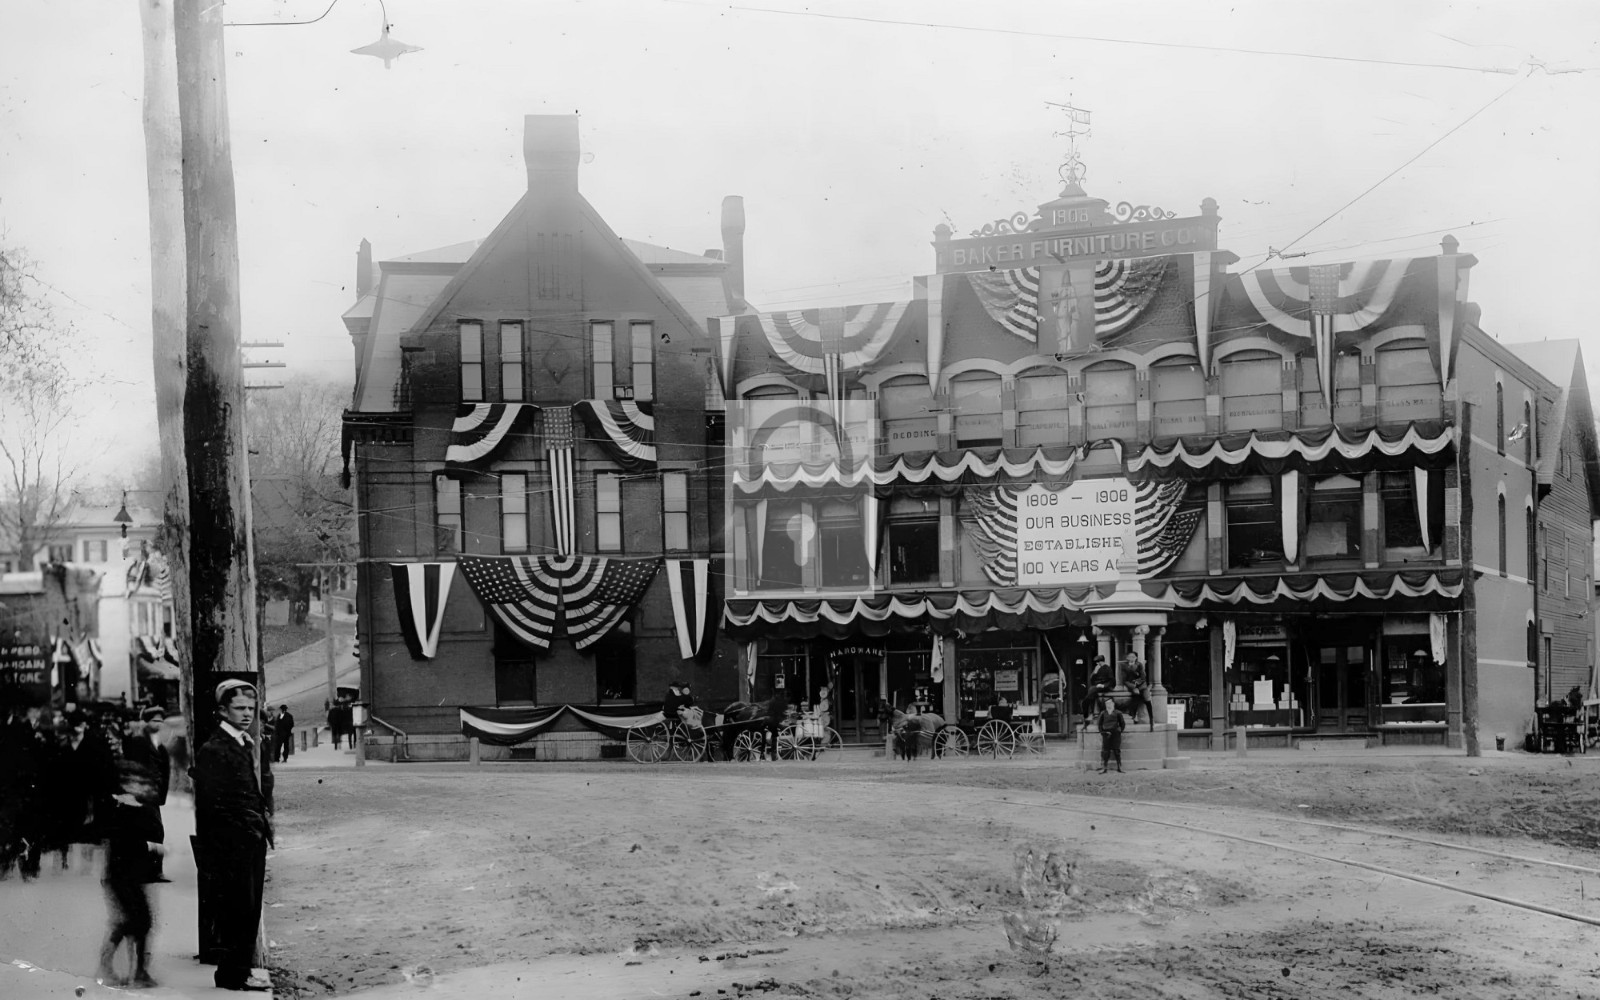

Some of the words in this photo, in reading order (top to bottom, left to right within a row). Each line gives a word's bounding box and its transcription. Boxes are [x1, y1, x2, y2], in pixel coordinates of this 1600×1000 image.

[953, 243, 1024, 266] BAKER
[1031, 232, 1156, 258] FURNITURE
[1161, 228, 1196, 246] CO.
[1026, 493, 1058, 507] 1808
[1096, 489, 1128, 503] 1908
[1025, 516, 1054, 529] OUR
[1060, 513, 1132, 528] BUSINESS
[1024, 537, 1122, 551] ESTABLISHE
[1023, 562, 1044, 574] 100
[1050, 560, 1099, 573] YEARS
